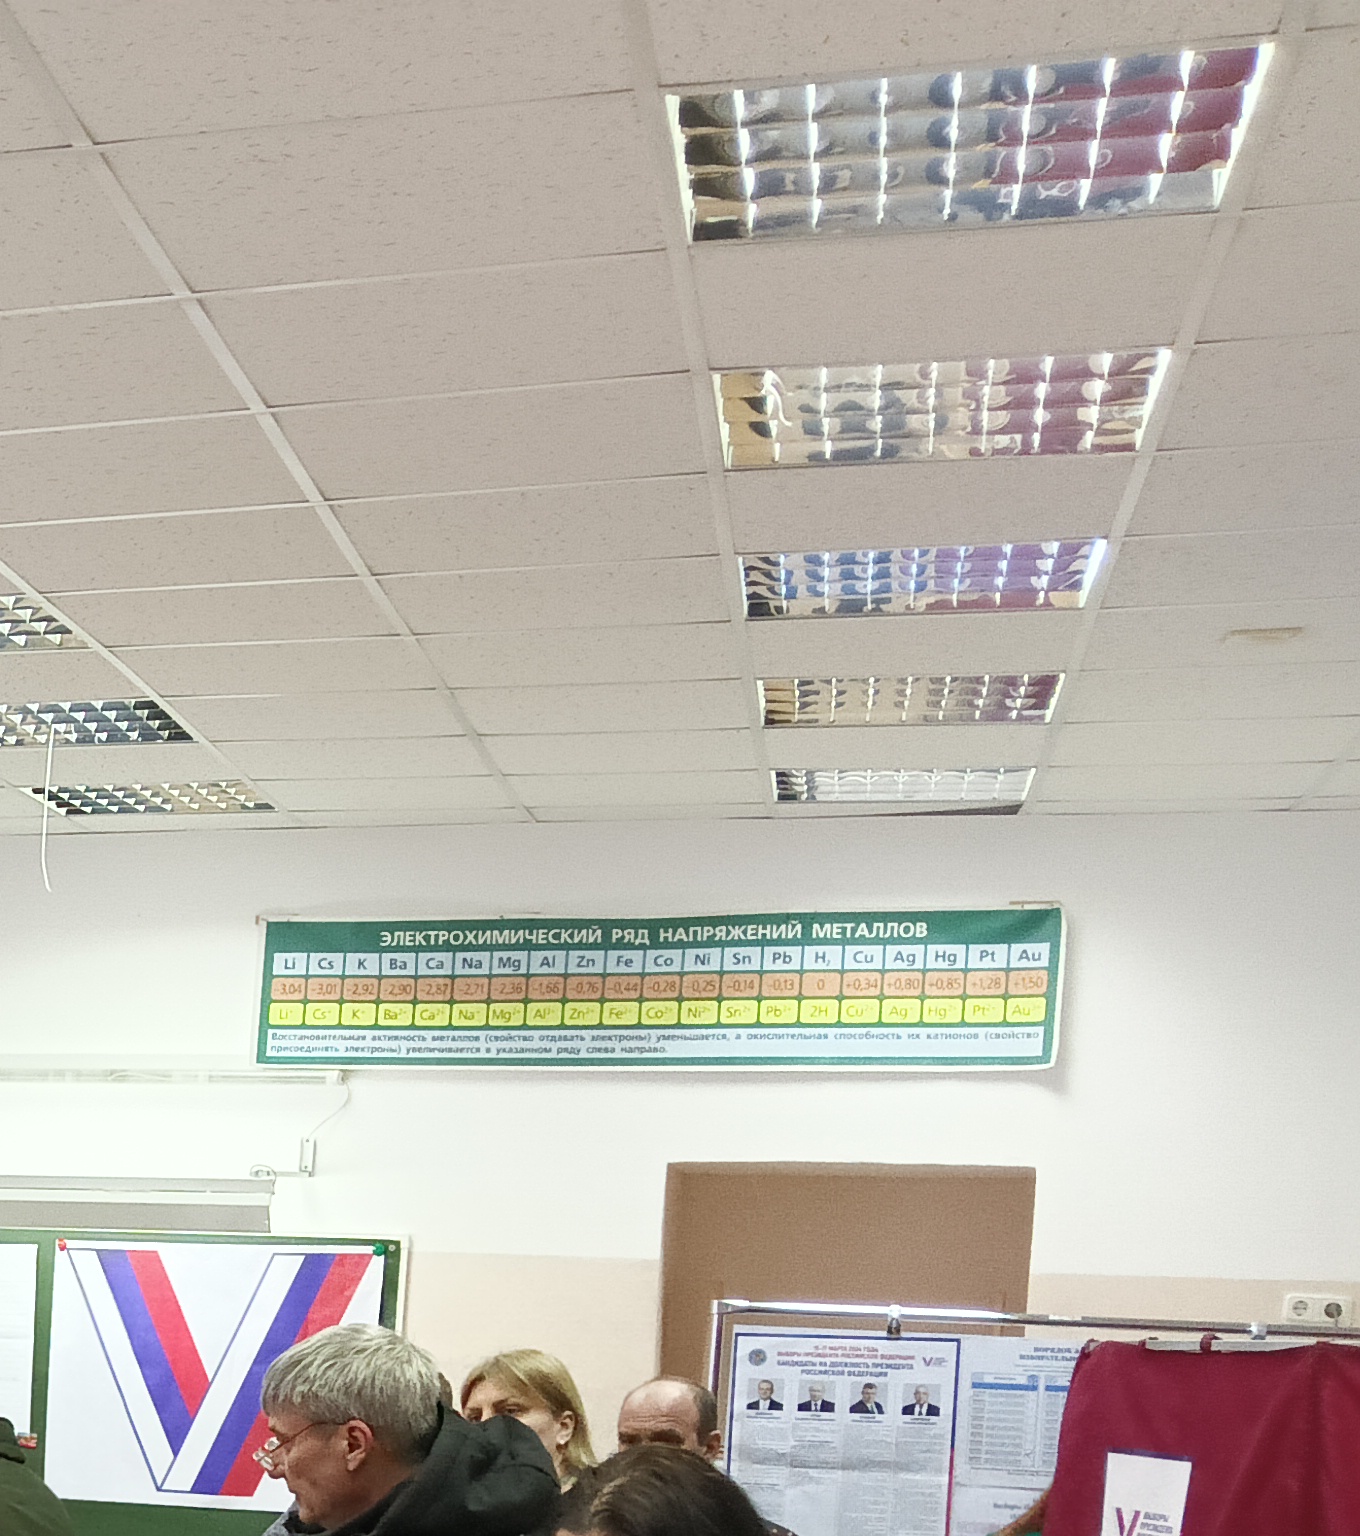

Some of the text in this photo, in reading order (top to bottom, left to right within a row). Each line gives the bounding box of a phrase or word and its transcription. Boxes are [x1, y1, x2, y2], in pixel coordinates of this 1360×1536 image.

[380, 920, 928, 947] ЭЛЕКТРОХИМИЧЕСКИЙ РЯД НАПРЯЖЕНИЙ МЕТАЛЛОВ
[284, 958, 296, 970] Li
[317, 958, 334, 970] Cs
[357, 958, 368, 970] K
[389, 958, 408, 970] Ba
[425, 957, 445, 970] Ca
[461, 957, 483, 970] Na
[497, 956, 522, 972] Mg
[539, 955, 556, 968] Al
[576, 955, 596, 968] Zn
[616, 955, 634, 968] Fe
[653, 954, 674, 968] Co
[694, 953, 711, 966] Ni
[732, 952, 752, 966] Sn
[772, 951, 793, 965] Pb
[852, 951, 874, 964] Cu
[893, 951, 917, 966] Ag
[934, 951, 957, 966] Hg
[979, 950, 996, 963] Pt
[1017, 949, 1042, 962] Au
[817, 978, 825, 990] 0
